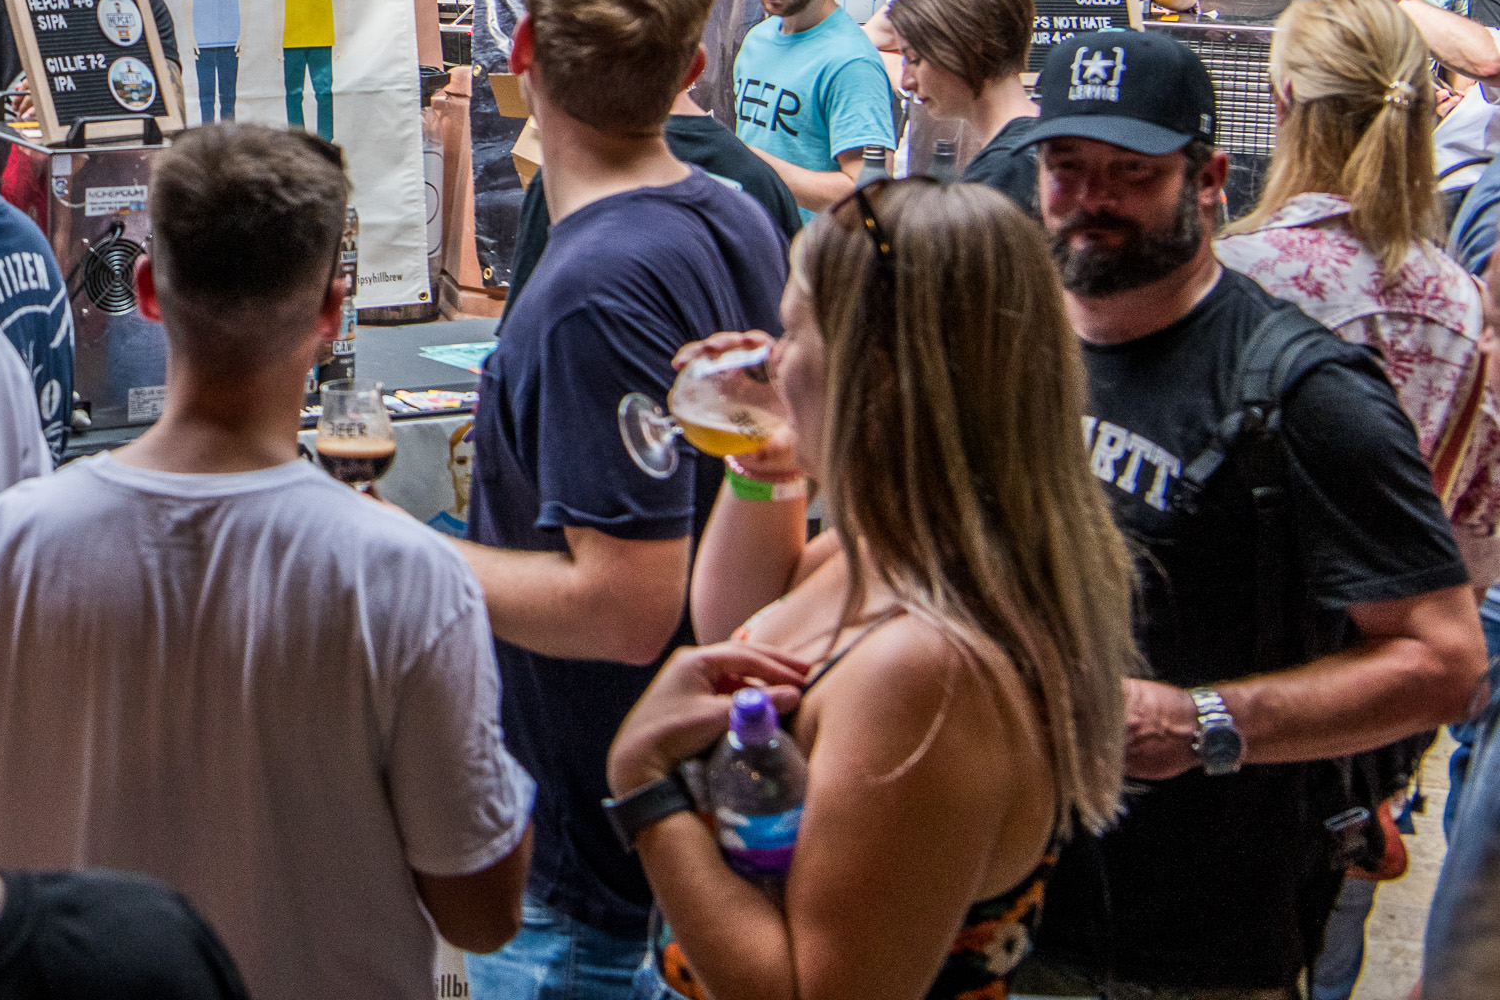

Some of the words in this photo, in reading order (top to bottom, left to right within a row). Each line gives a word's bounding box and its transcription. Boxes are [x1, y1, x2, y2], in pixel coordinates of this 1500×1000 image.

[37, 13, 68, 32] SIPA
[1053, 16, 1079, 29] NOT
[1080, 16, 1113, 29] HATE
[45, 55, 87, 74] GILLIE
[53, 74, 76, 92] IPA
[356, 272, 403, 287] ipsyhillbrew
